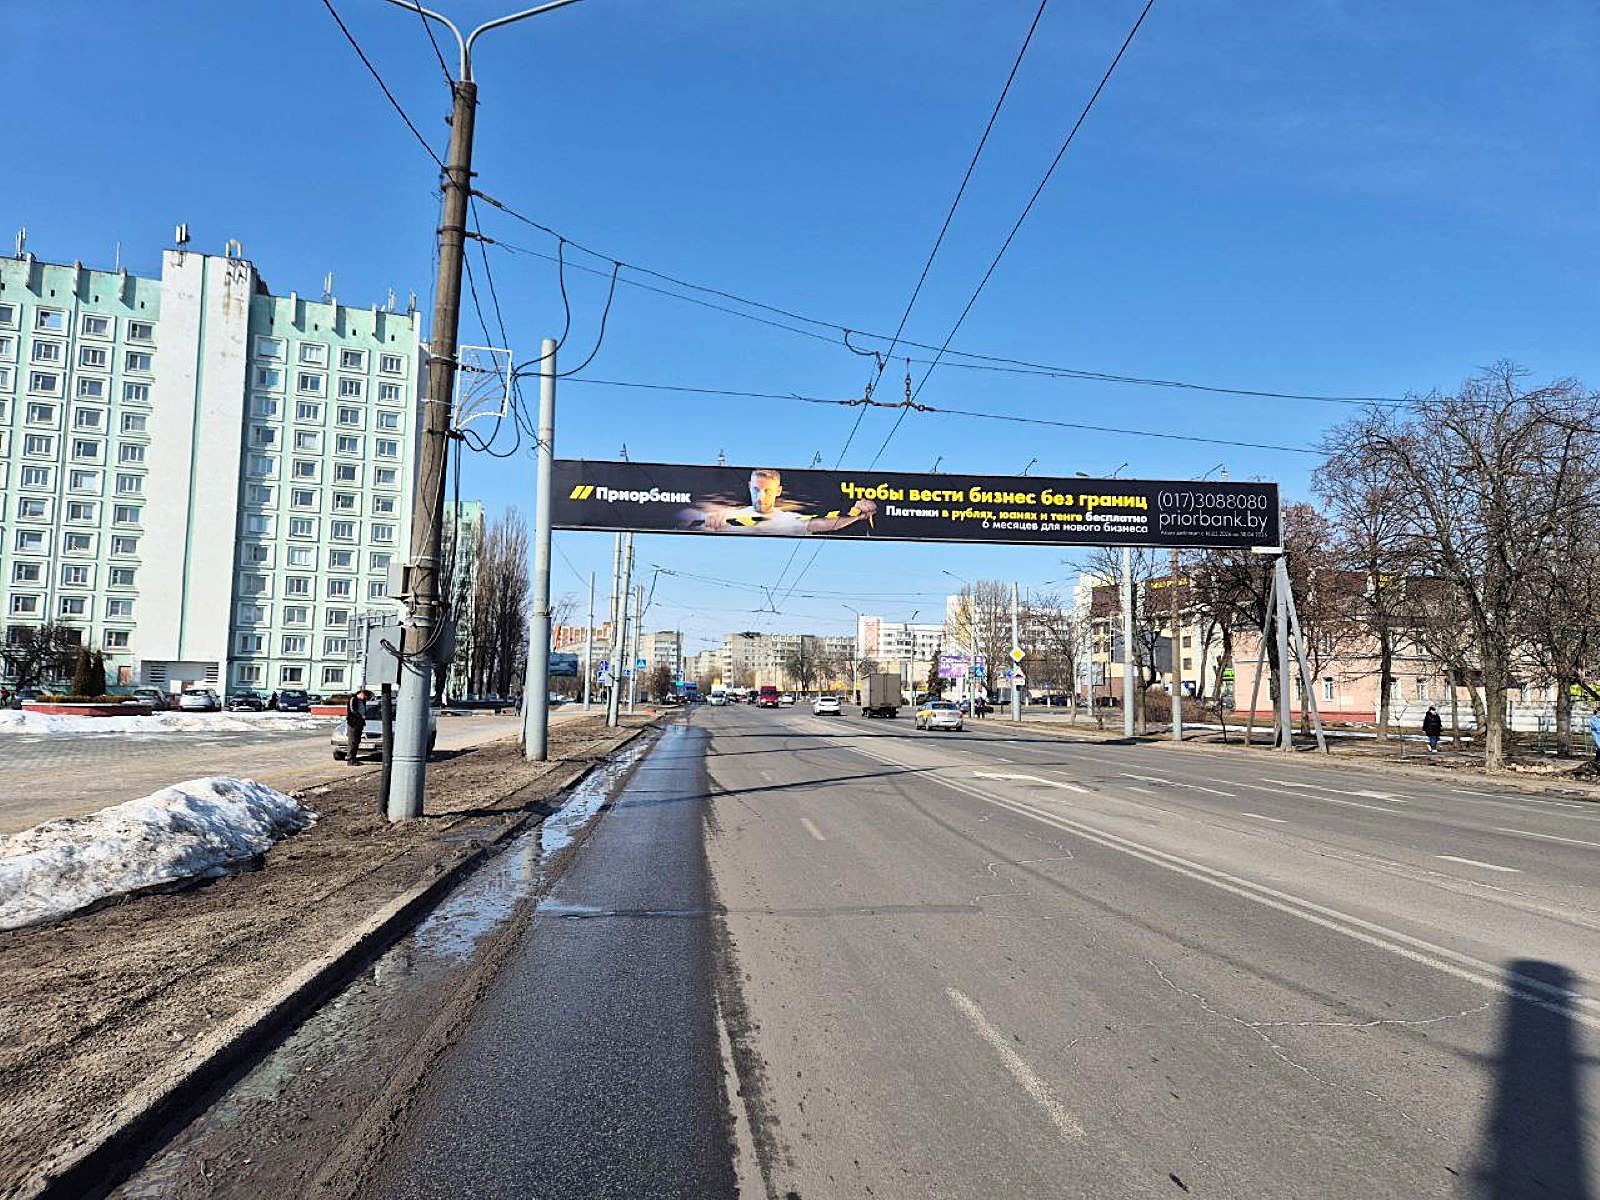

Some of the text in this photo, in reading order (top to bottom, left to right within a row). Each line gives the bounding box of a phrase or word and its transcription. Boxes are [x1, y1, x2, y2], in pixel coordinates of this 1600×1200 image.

[596, 486, 692, 504] Приорбанк
[840, 482, 1148, 511] Чтобы вести бизнес без границ
[1158, 490, 1268, 511] (017)3088080
[885, 505, 1148, 523] Платежи в рублях, юанях и тенге бесплатно
[1159, 510, 1268, 533] priorbank.by
[982, 519, 1148, 533] 6 месяцев для нового бизнеса
